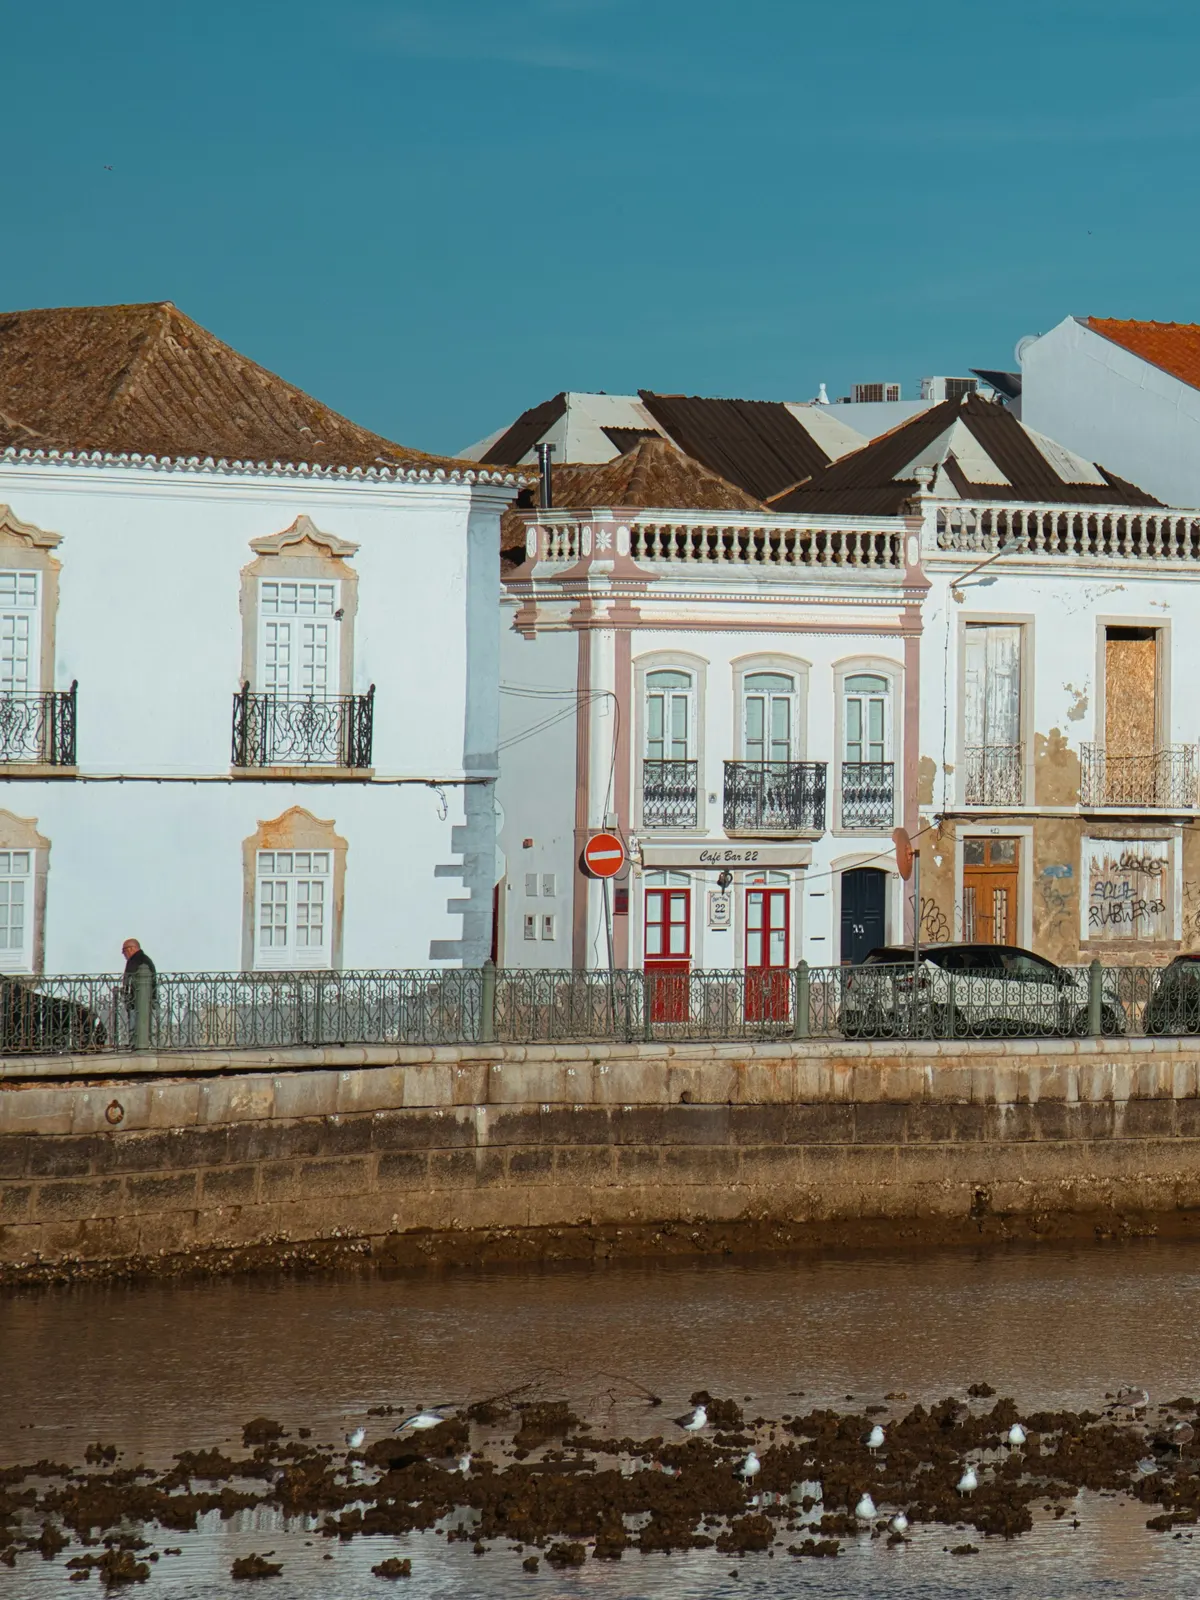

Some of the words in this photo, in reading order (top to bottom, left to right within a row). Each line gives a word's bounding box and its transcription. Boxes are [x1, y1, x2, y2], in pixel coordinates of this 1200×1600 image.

[699, 849, 721, 864] Café
[724, 850, 742, 861] Bar
[745, 851, 759, 861] 22
[715, 903, 726, 913] 22
